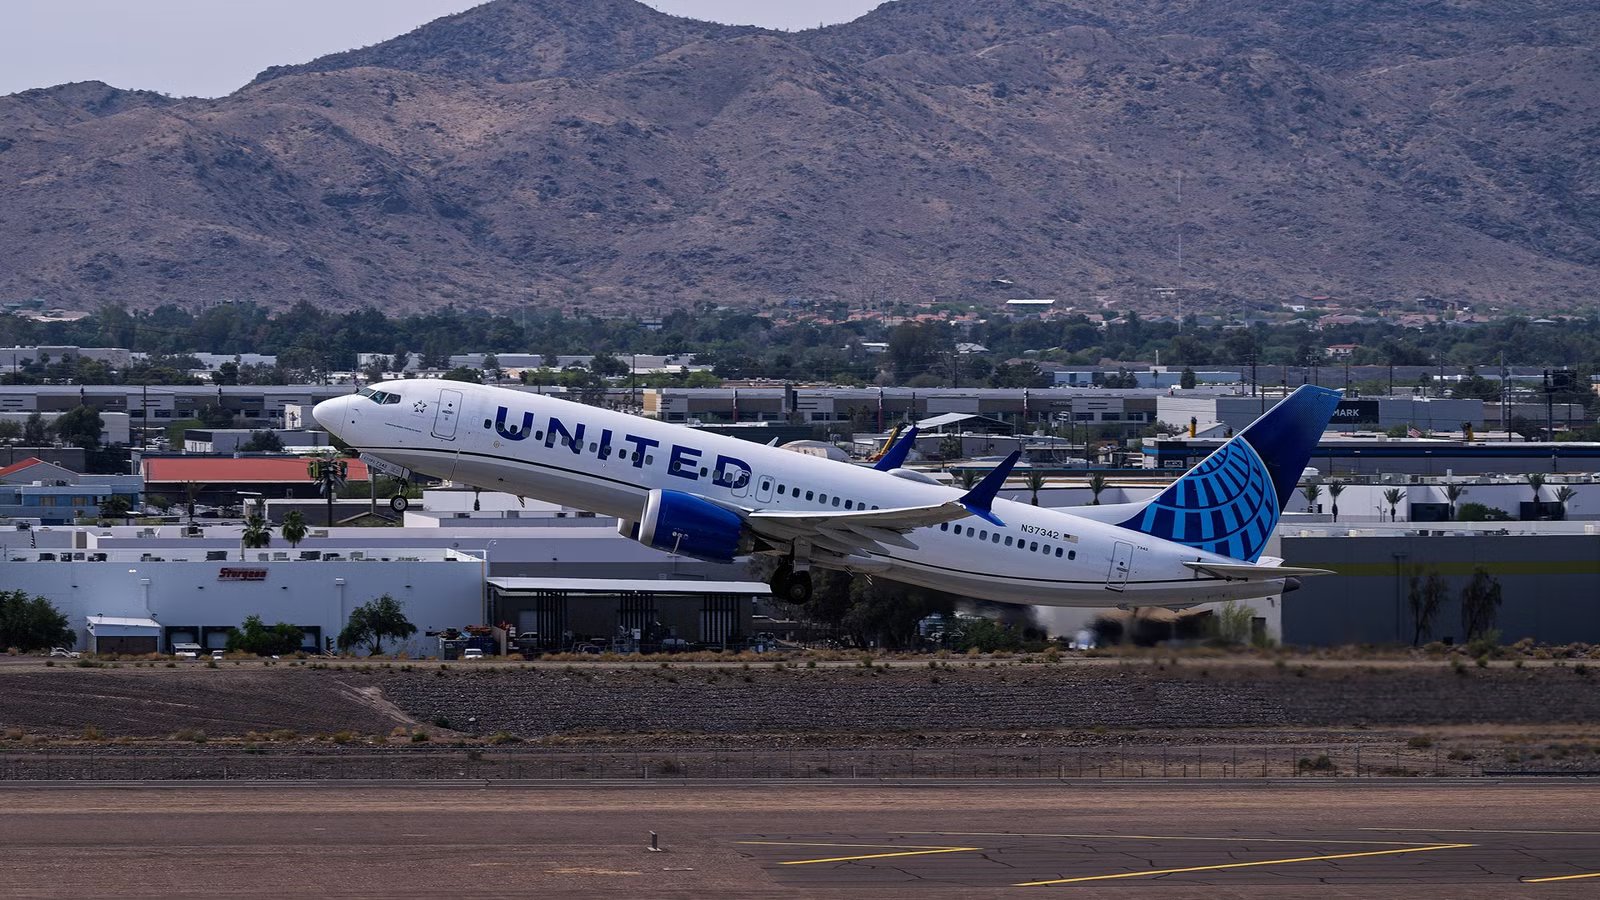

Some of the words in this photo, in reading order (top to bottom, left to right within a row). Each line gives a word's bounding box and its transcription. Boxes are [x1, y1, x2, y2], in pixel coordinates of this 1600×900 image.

[1332, 408, 1360, 417] MARK
[495, 406, 752, 489] UNITED
[1020, 524, 1060, 540] N37342
